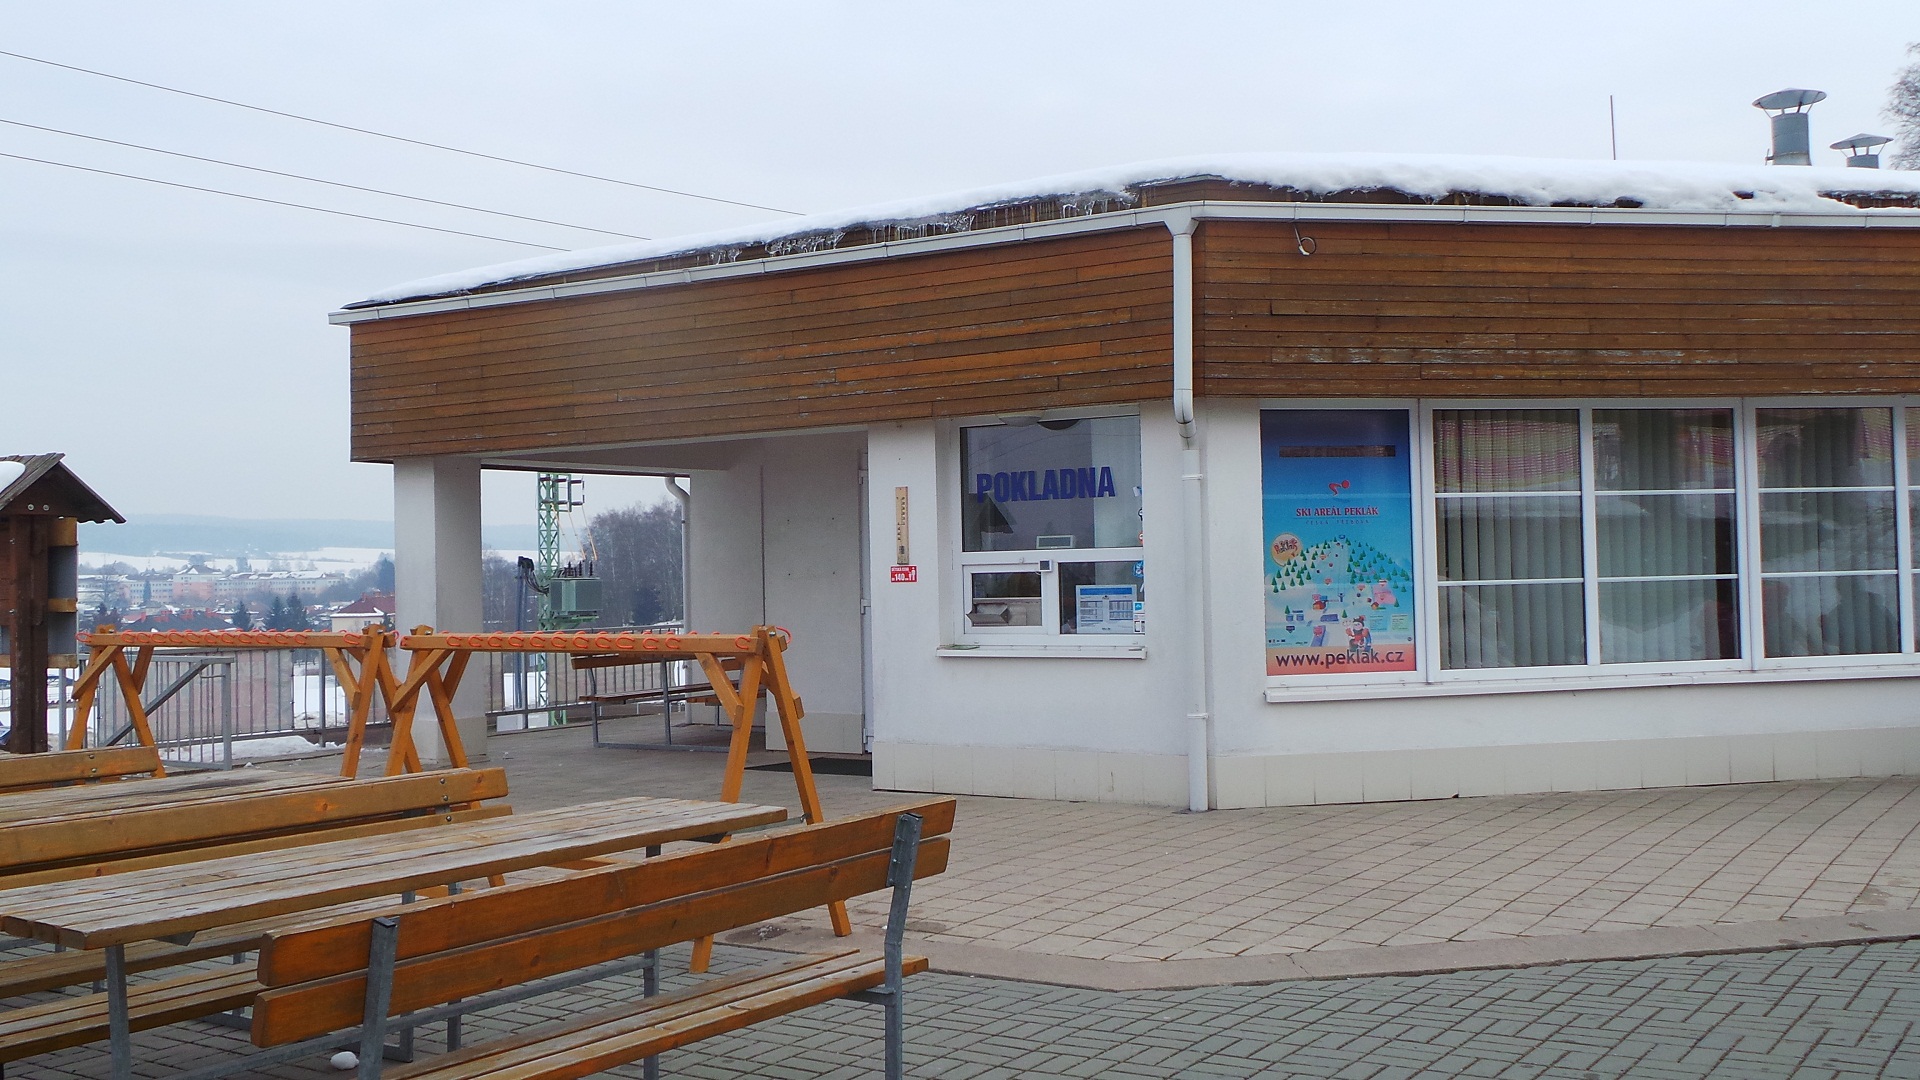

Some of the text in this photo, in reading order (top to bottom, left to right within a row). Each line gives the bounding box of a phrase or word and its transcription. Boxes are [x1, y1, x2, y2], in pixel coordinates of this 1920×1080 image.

[976, 466, 1116, 504] POKLADNA
[1296, 505, 1379, 517] SKI AREÁL PEKLÁK
[1275, 648, 1405, 669] www.peklak.cz
